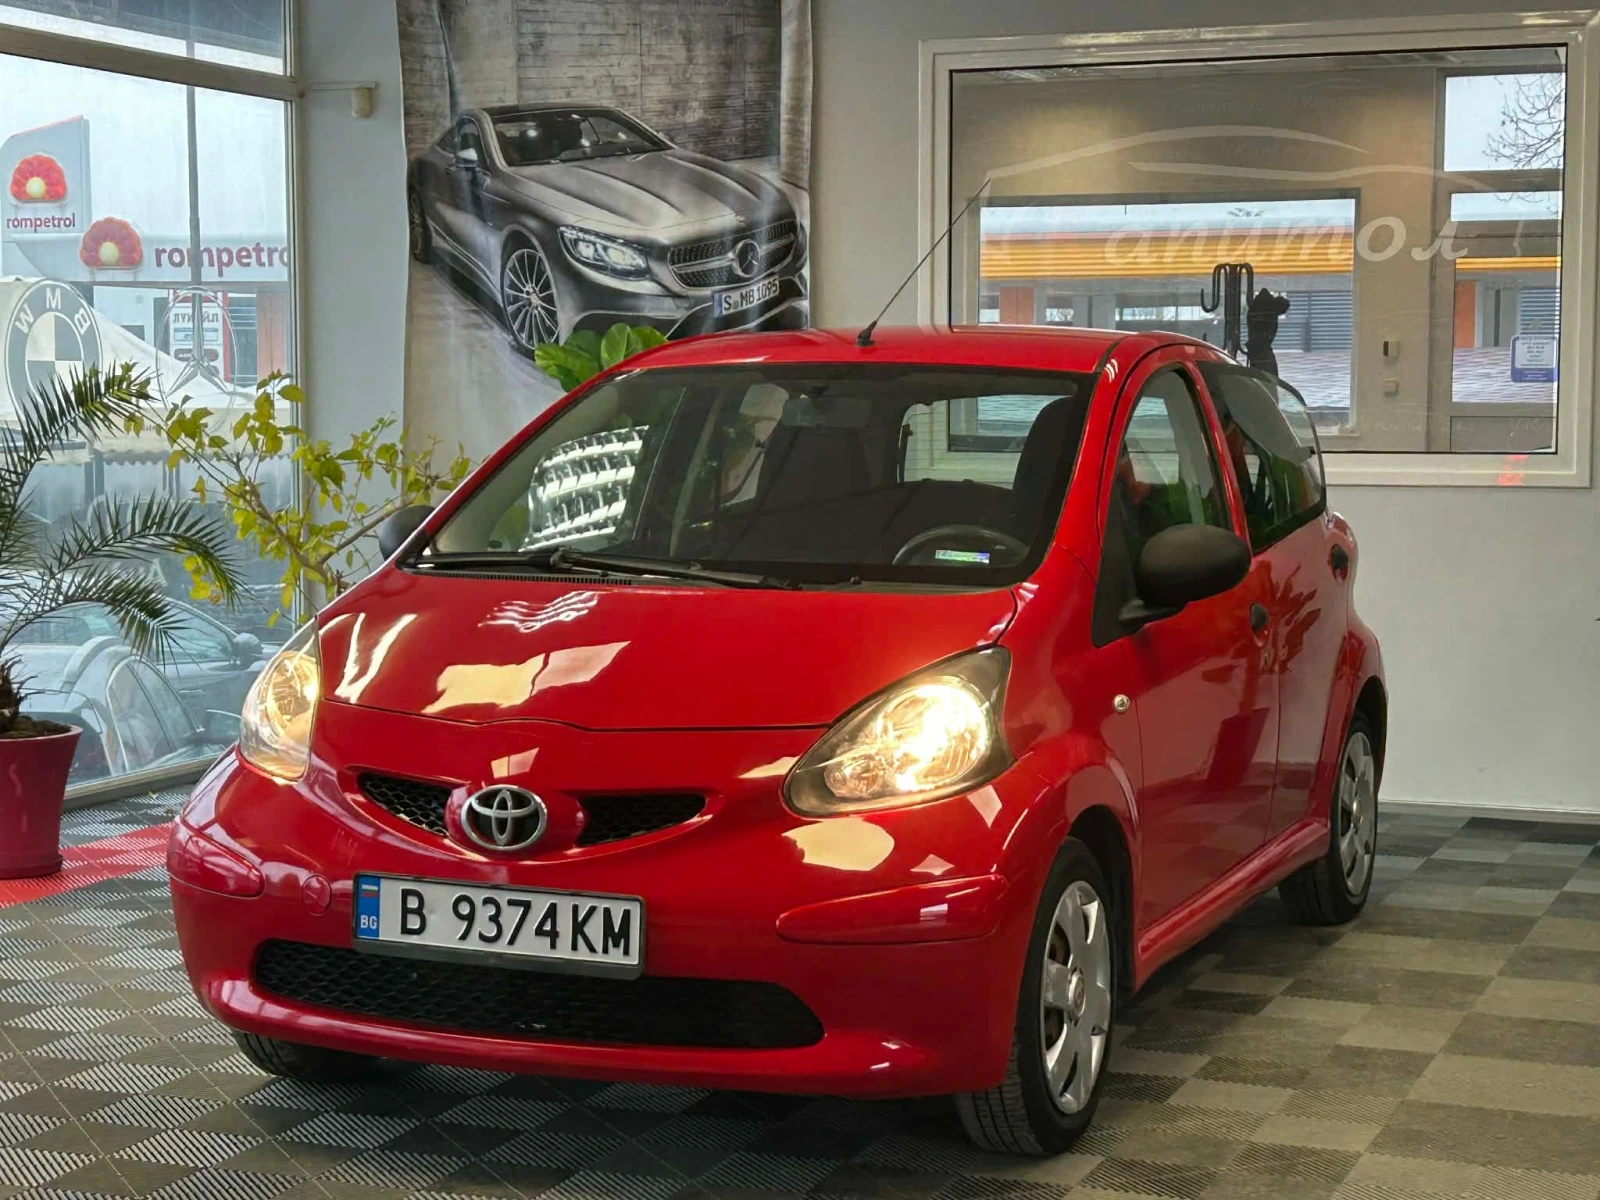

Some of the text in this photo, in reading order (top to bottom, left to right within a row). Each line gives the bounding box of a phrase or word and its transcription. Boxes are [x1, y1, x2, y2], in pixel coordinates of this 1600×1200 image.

[6, 212, 76, 233] rompetrol
[724, 295, 732, 311] S
[360, 914, 378, 930] BG
[452, 894, 560, 950] 9374
